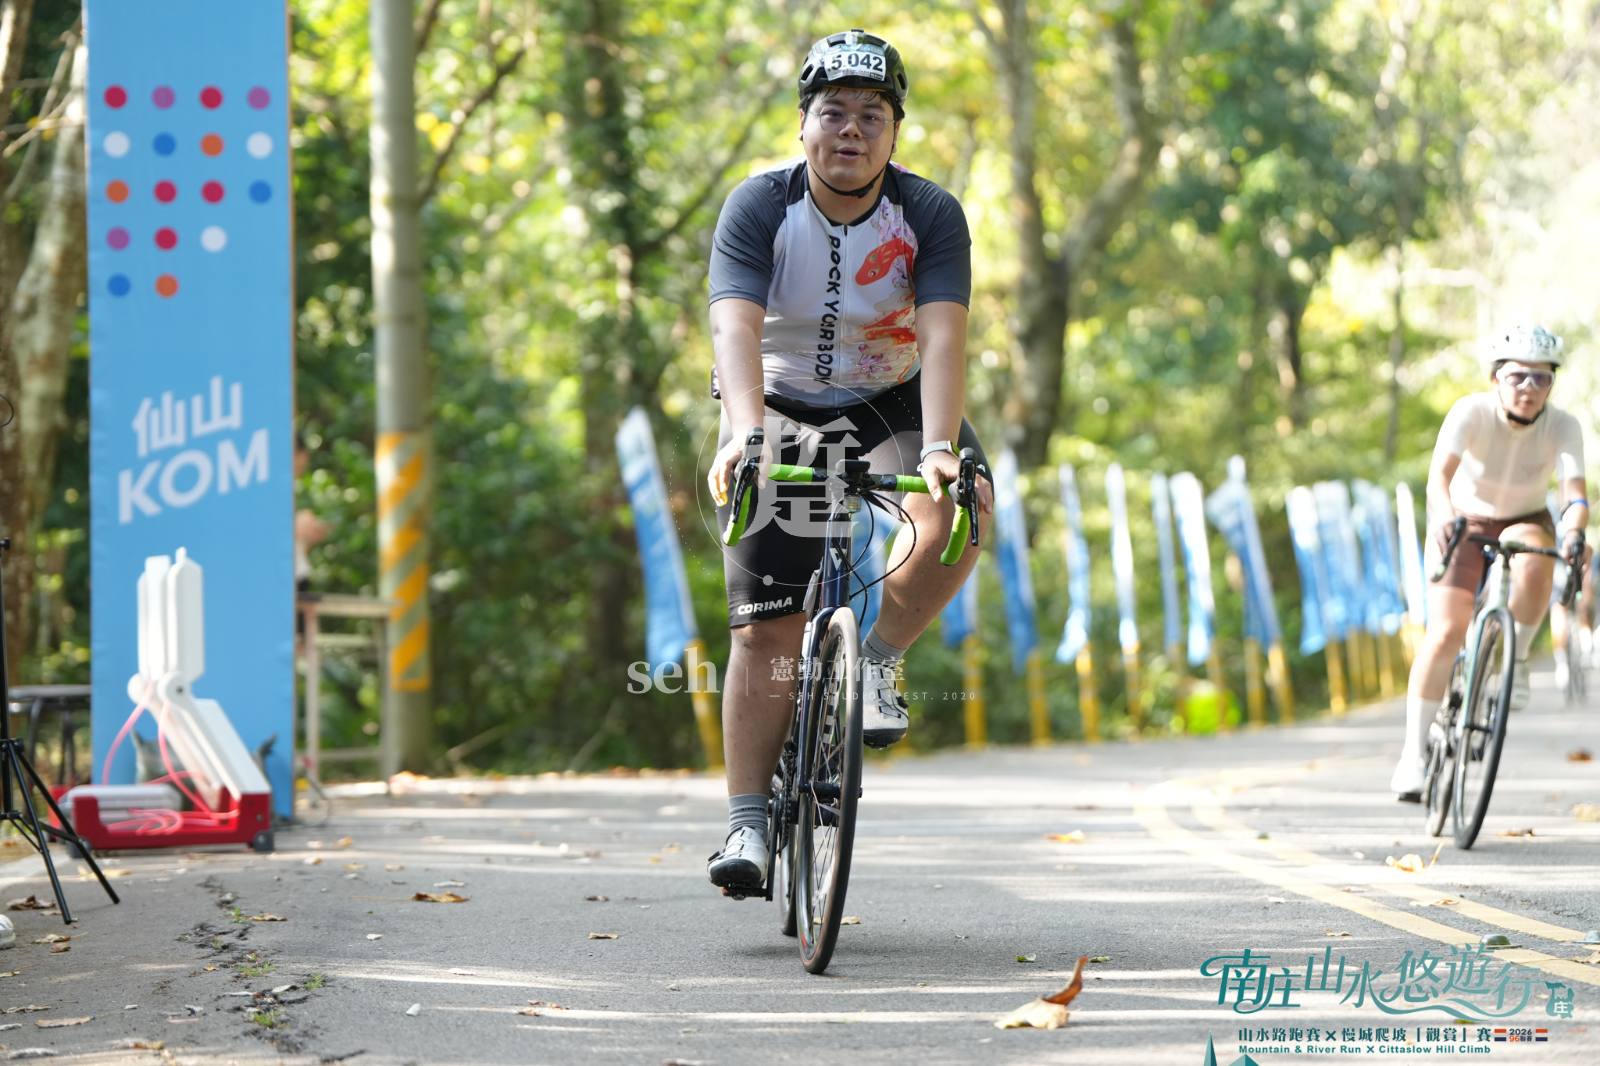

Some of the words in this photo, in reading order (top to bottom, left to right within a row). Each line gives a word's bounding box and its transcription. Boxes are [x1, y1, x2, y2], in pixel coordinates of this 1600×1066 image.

[830, 52, 883, 73] 5042
[131, 374, 243, 459] 仙山
[118, 427, 269, 525] KOM
[738, 596, 793, 616] CORIMA
